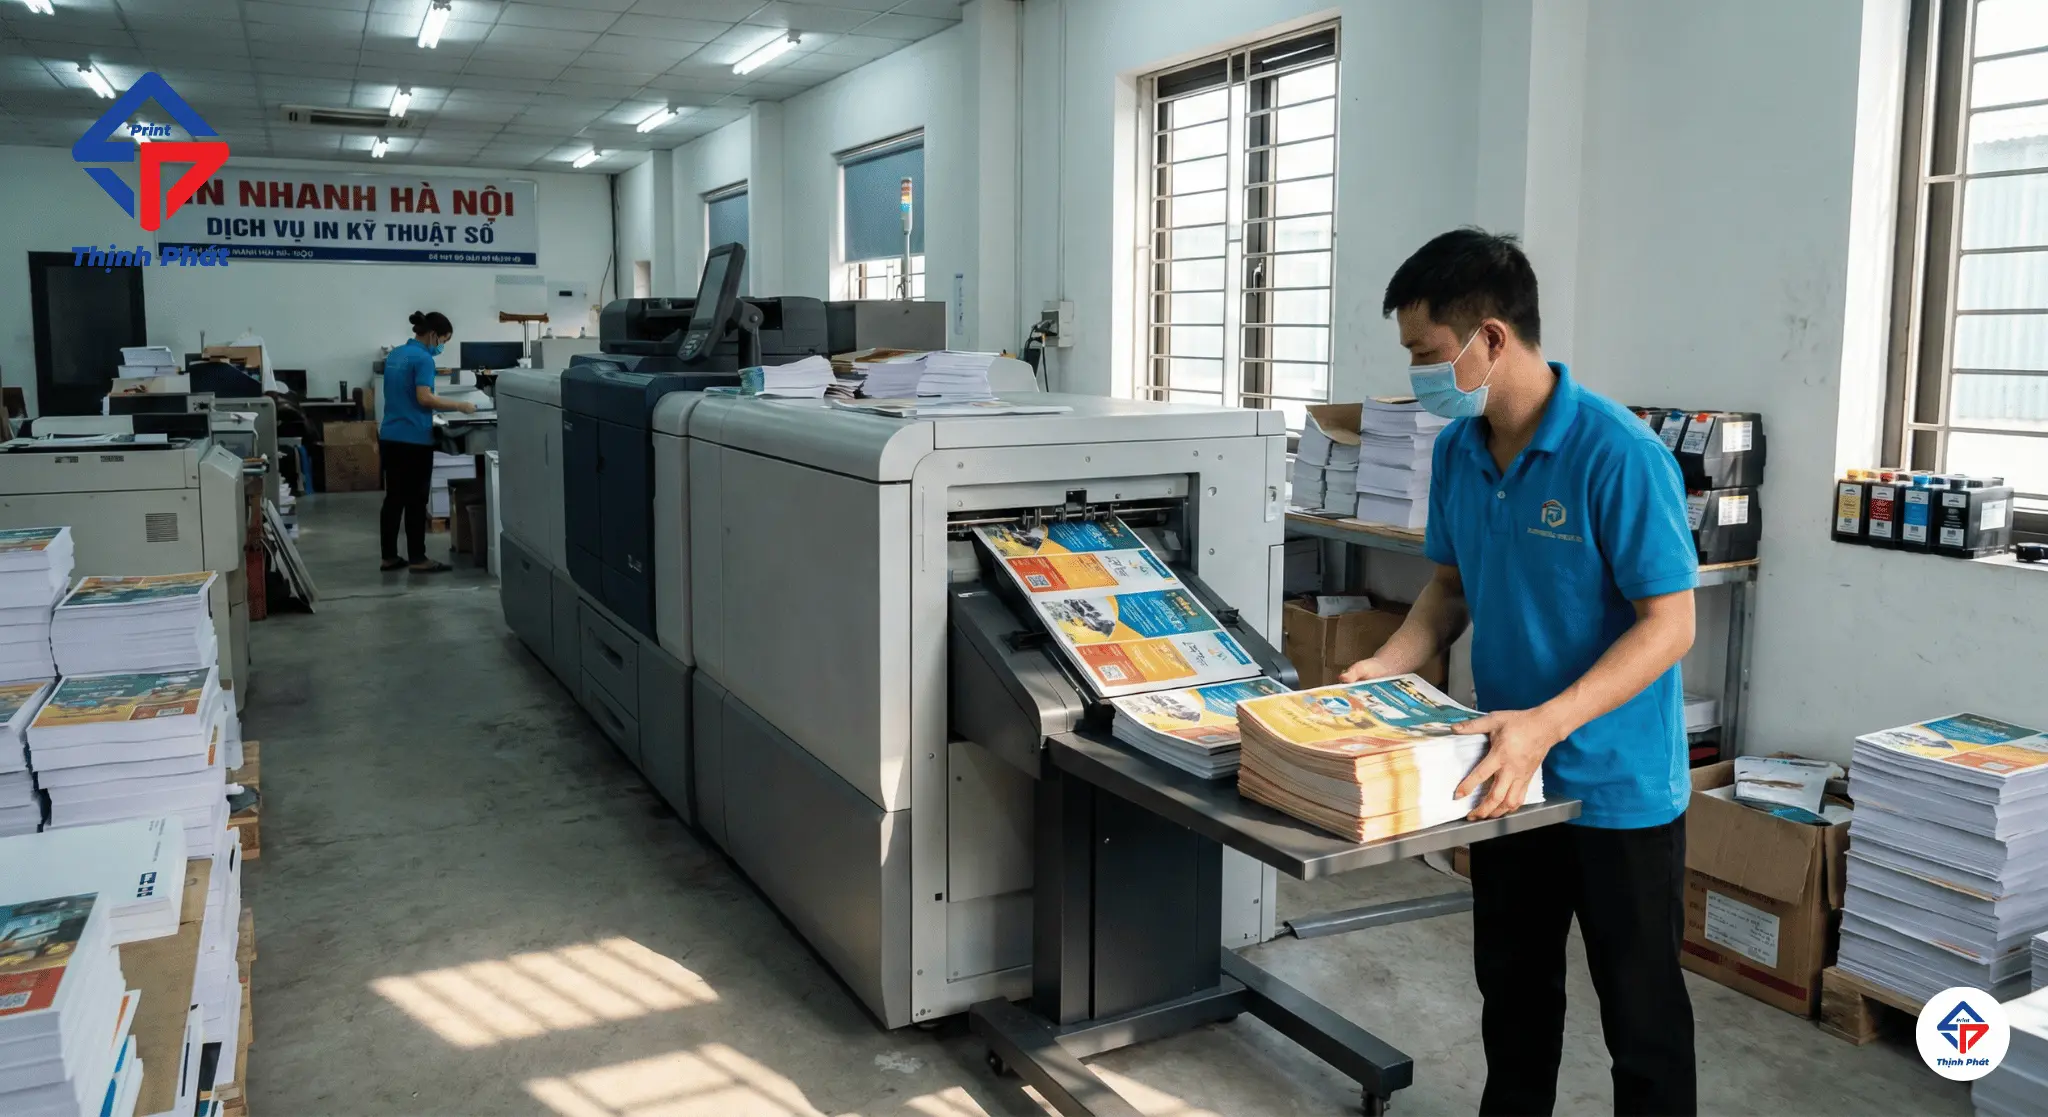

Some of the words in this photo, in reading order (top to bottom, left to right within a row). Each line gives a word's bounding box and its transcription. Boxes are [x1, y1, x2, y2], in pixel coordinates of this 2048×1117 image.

[184, 179, 225, 206] N
[239, 179, 376, 212] NHANH
[390, 181, 441, 214] HÀ
[452, 185, 514, 222] NỘI
[206, 217, 266, 240] DỊCH
[273, 219, 305, 243] VỤ
[314, 221, 339, 239] IN
[347, 219, 376, 241] KỸ
[384, 221, 457, 247] THUẬT
[464, 221, 494, 244] SỐ
